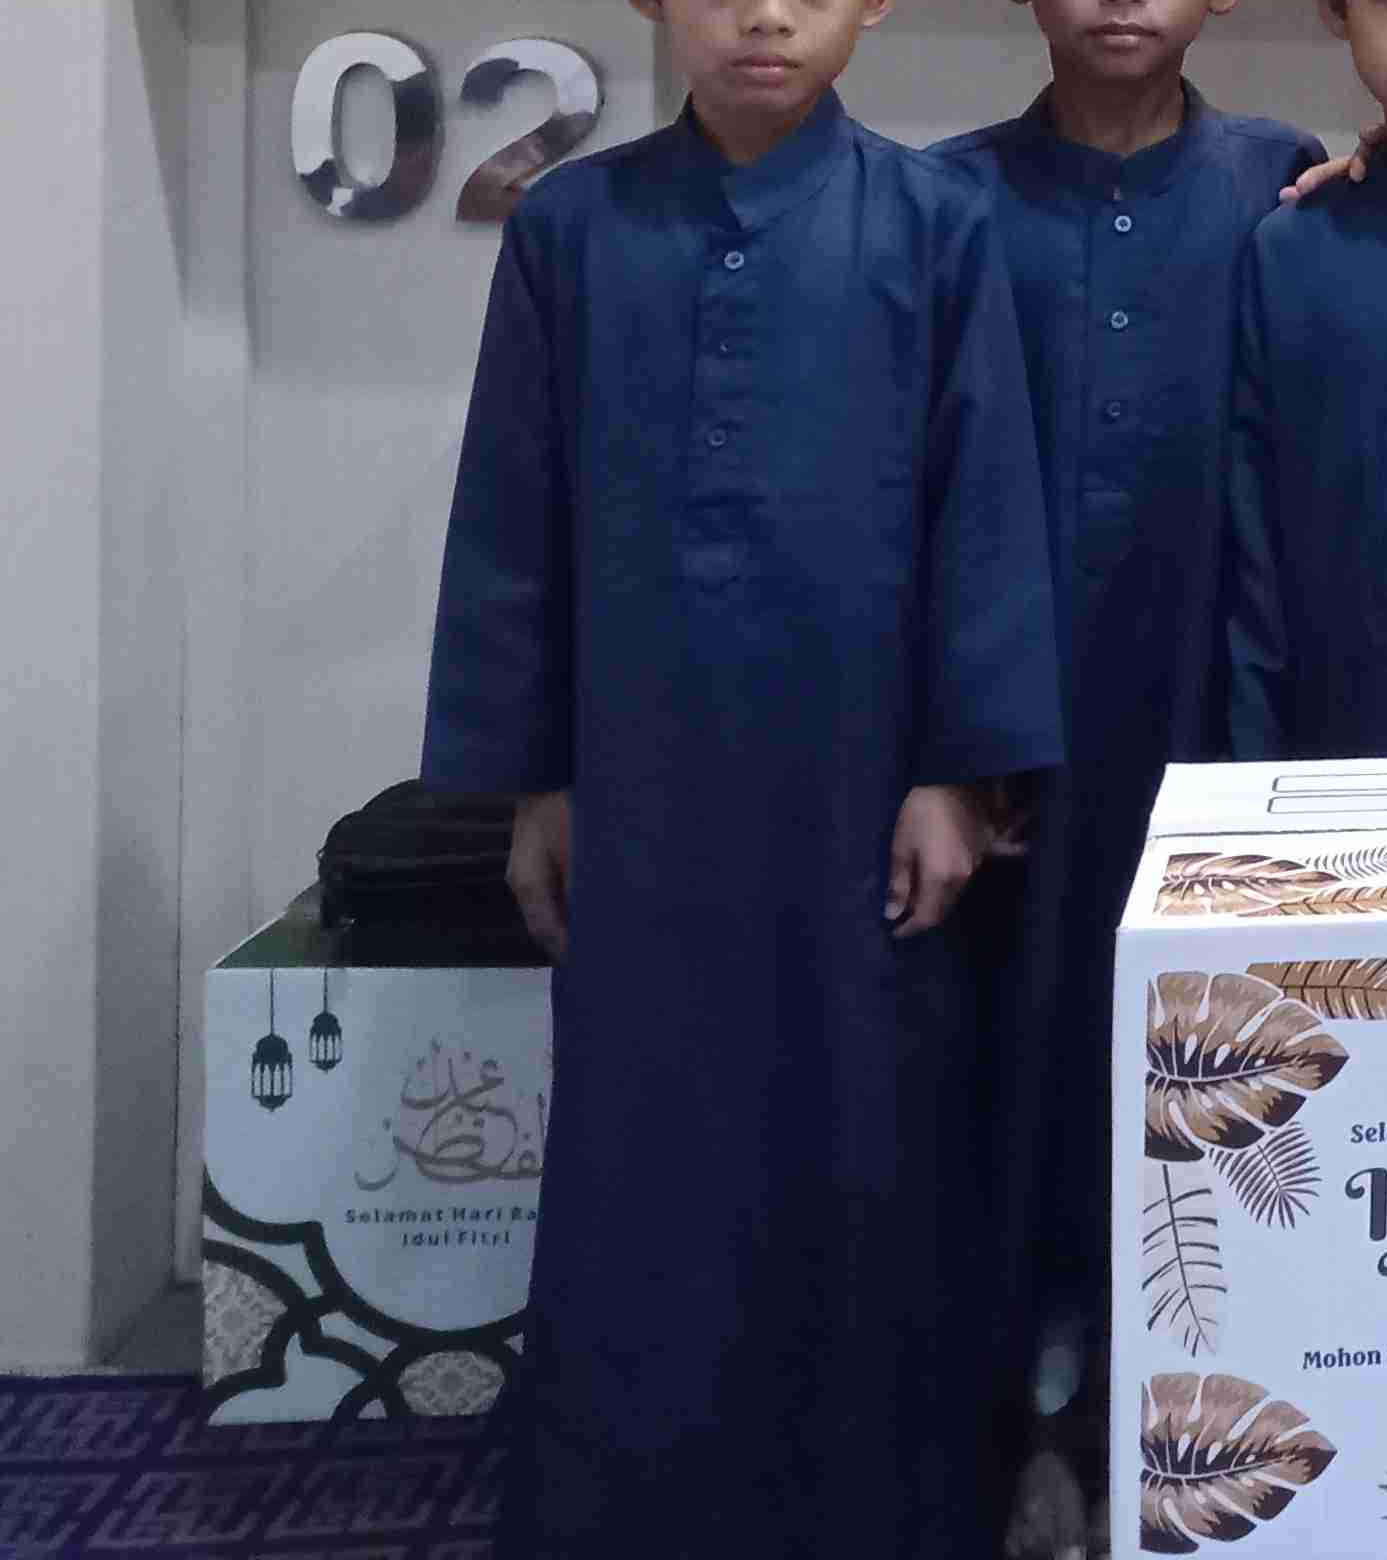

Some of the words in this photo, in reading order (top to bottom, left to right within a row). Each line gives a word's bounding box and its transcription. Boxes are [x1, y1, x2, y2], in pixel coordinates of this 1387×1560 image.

[291, 31, 600, 223] 02
[345, 1209, 443, 1224] Selamat
[452, 1207, 502, 1223] Hari
[1302, 1347, 1381, 1370] Mohon
